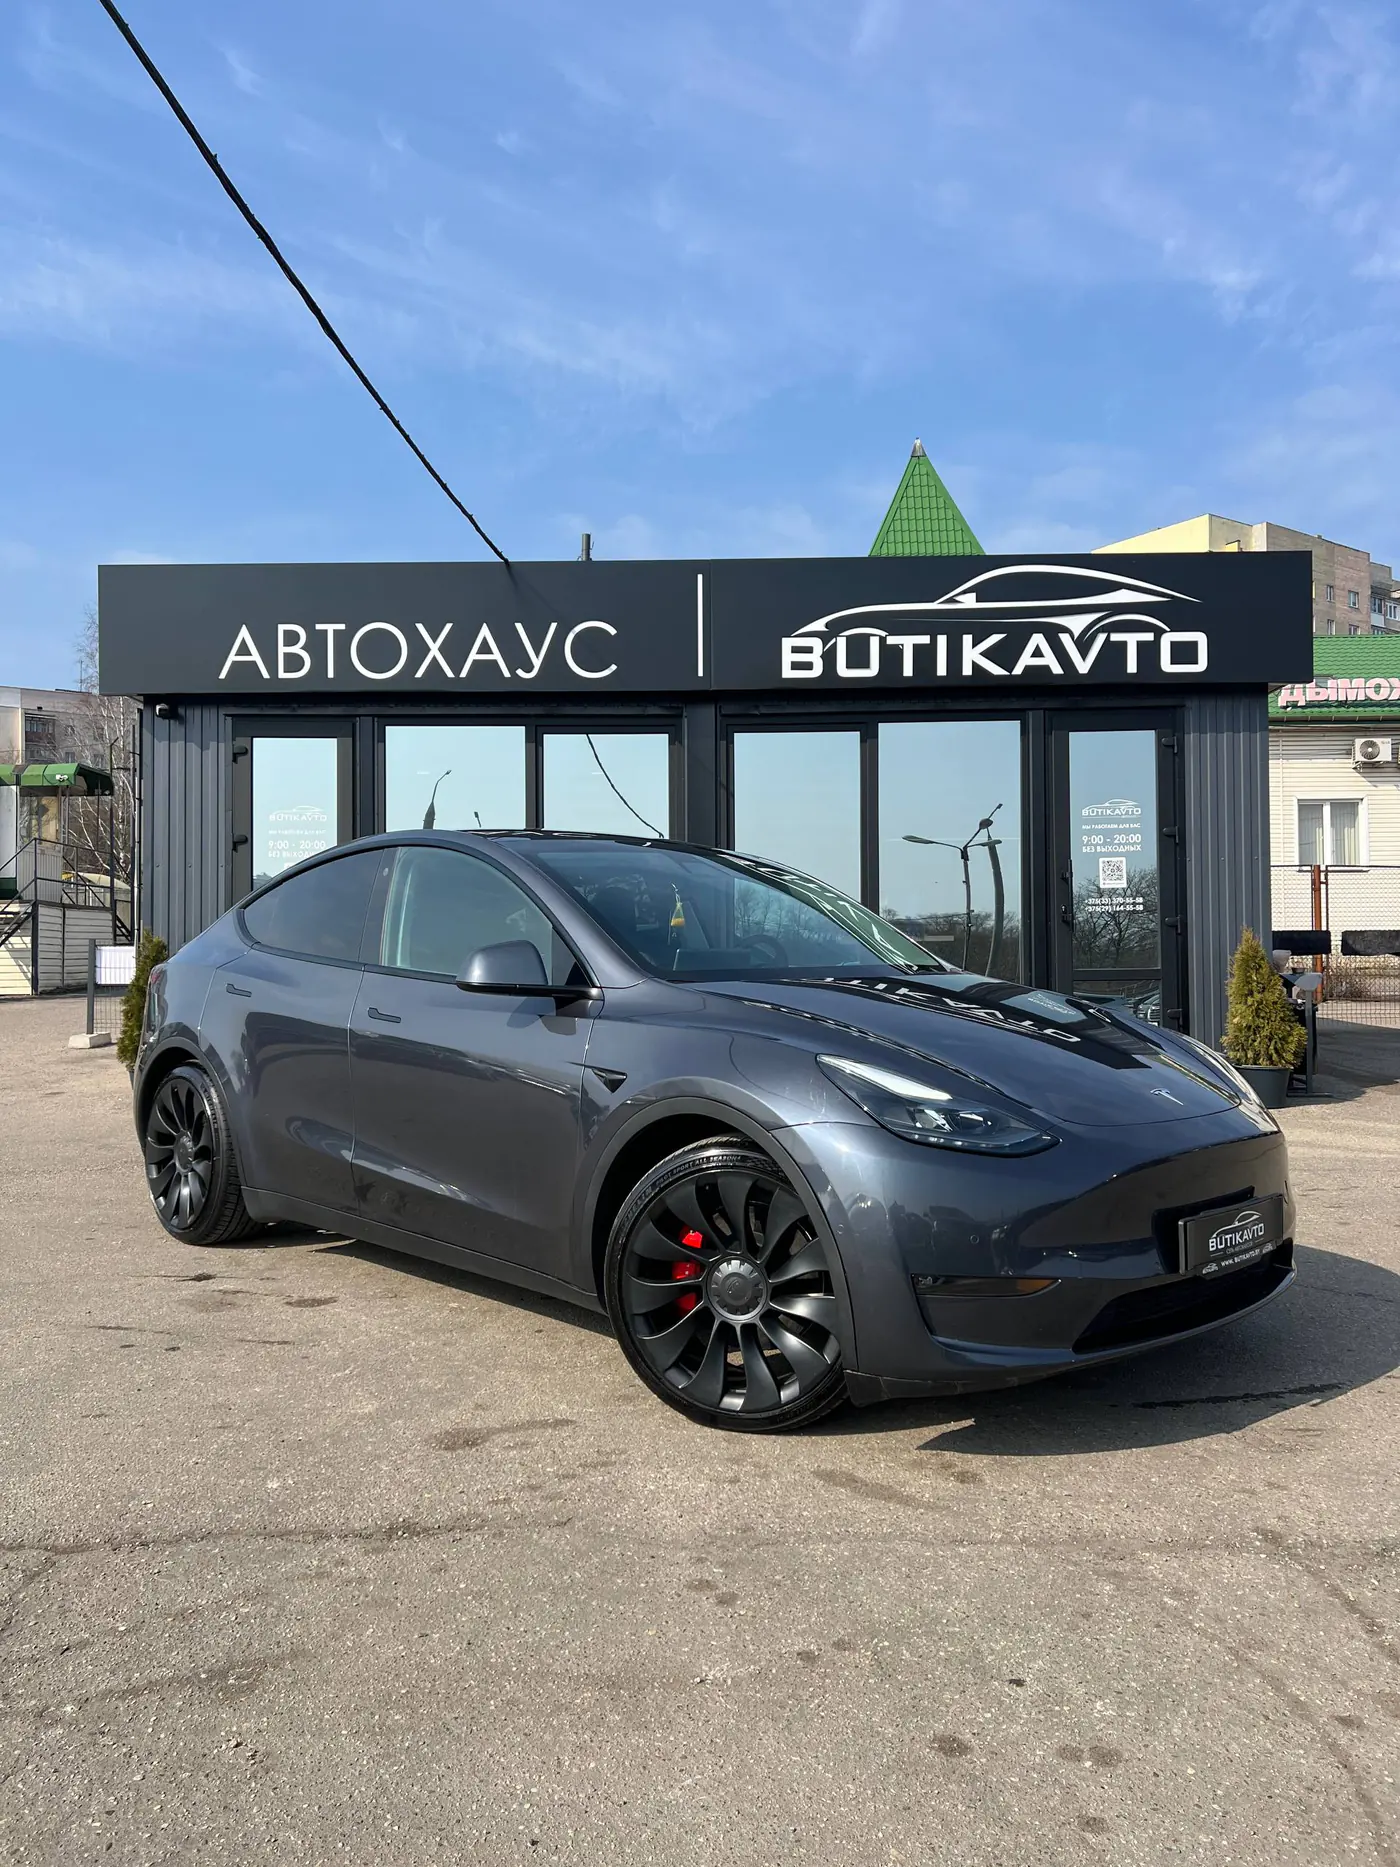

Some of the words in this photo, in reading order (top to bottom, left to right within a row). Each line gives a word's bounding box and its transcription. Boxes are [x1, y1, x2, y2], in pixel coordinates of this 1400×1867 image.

[218, 621, 618, 679] АВТОХАУС
[781, 631, 1209, 679] BUTIKAVTO
[1082, 807, 1142, 816] BUTIKAVTO
[268, 840, 289, 850] 9:00
[299, 840, 326, 850] 20:00
[1082, 834, 1104, 845] 9:00
[1113, 833, 1142, 844] 20:00
[1082, 845, 1095, 853] БЕЗ
[1096, 844, 1142, 853] ВЫХОДНЫХ
[1209, 1223, 1265, 1252] BUTIKAVTO
